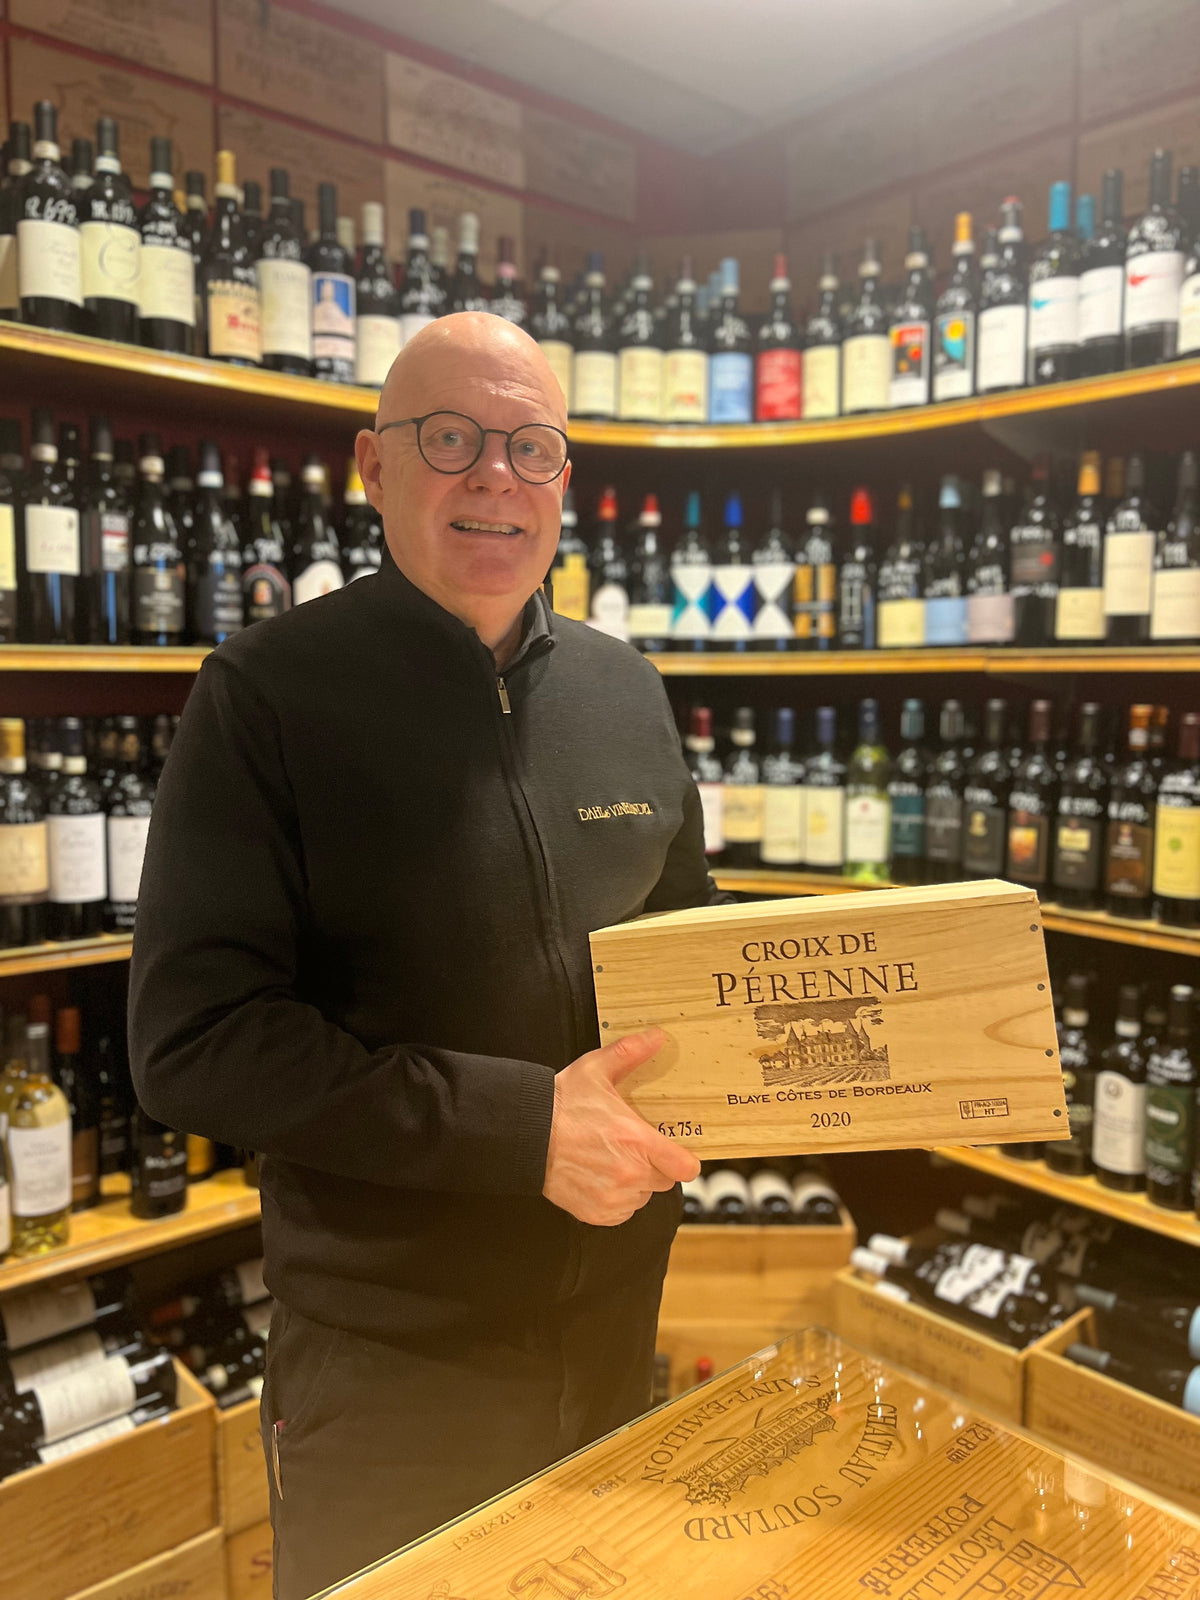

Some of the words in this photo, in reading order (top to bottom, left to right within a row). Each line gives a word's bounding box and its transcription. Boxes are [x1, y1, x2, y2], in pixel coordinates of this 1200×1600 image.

[741, 936, 833, 963] CROIX
[837, 930, 878, 956] DE
[712, 961, 919, 1007] PÉRENNE
[810, 1110, 851, 1129] 2020
[683, 1484, 843, 1542] SOUTARD
[858, 1491, 988, 1597] POYFERRÉ
